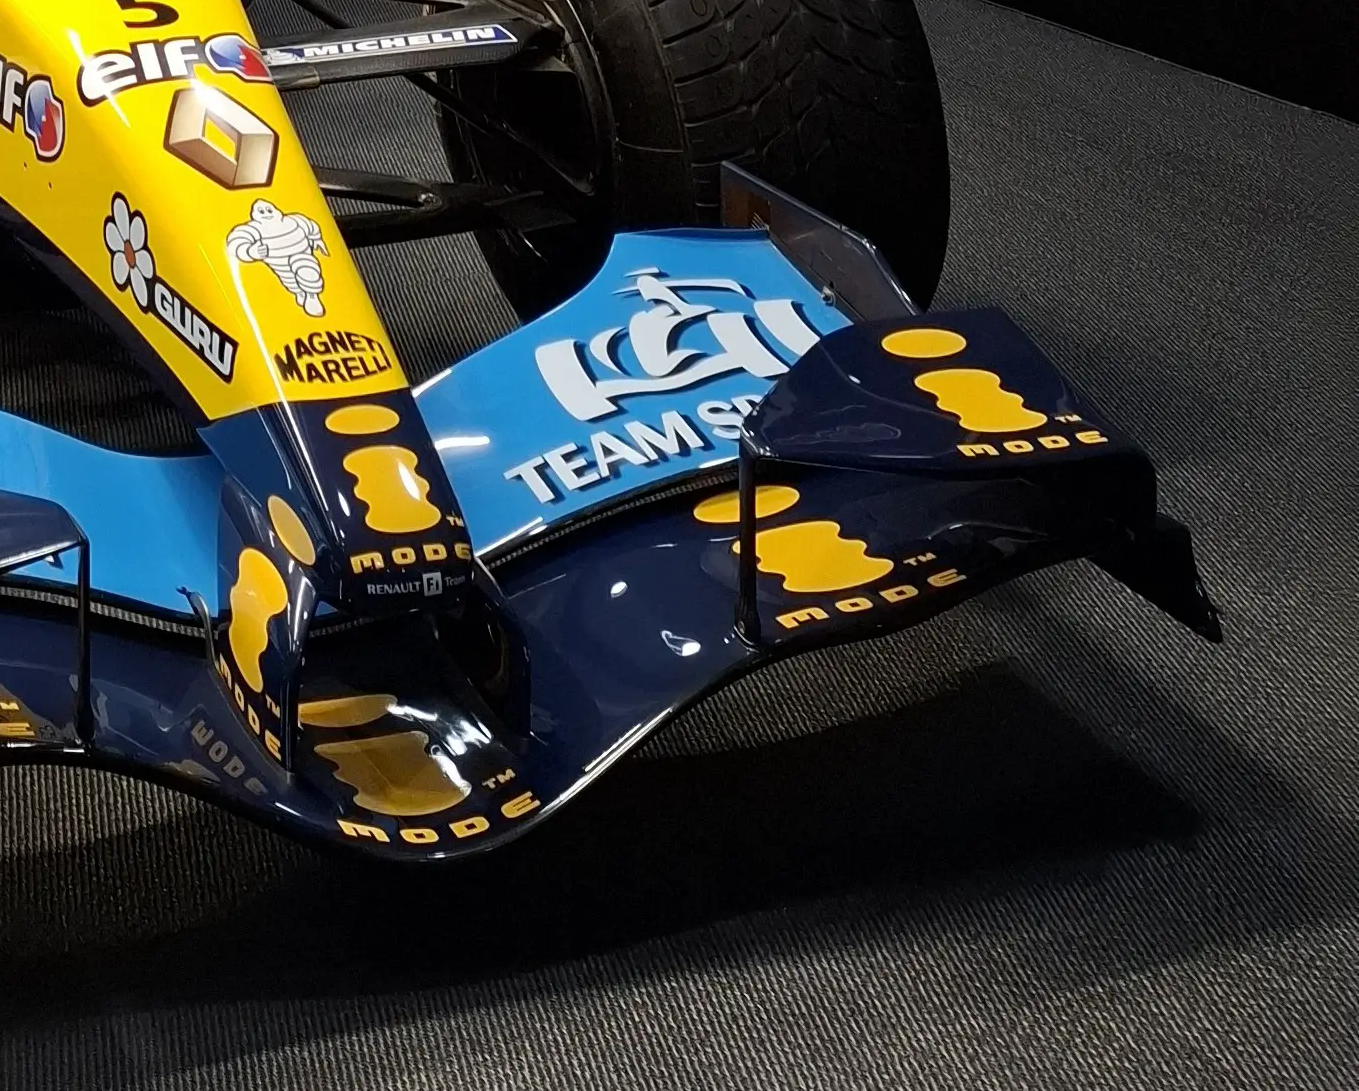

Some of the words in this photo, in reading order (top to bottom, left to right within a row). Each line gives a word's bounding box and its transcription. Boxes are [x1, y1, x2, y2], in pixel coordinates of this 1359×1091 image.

[80, 38, 200, 102] elf
[304, 27, 496, 57] MICHELIN
[154, 282, 234, 376] GURU
[503, 410, 705, 504] TEAM
[956, 430, 1109, 457] MODE
[350, 543, 472, 574] MODE
[367, 581, 422, 595] RENAULT
[775, 568, 967, 629] MODE
[219, 652, 282, 761] MODE
[336, 791, 541, 844] MODE
